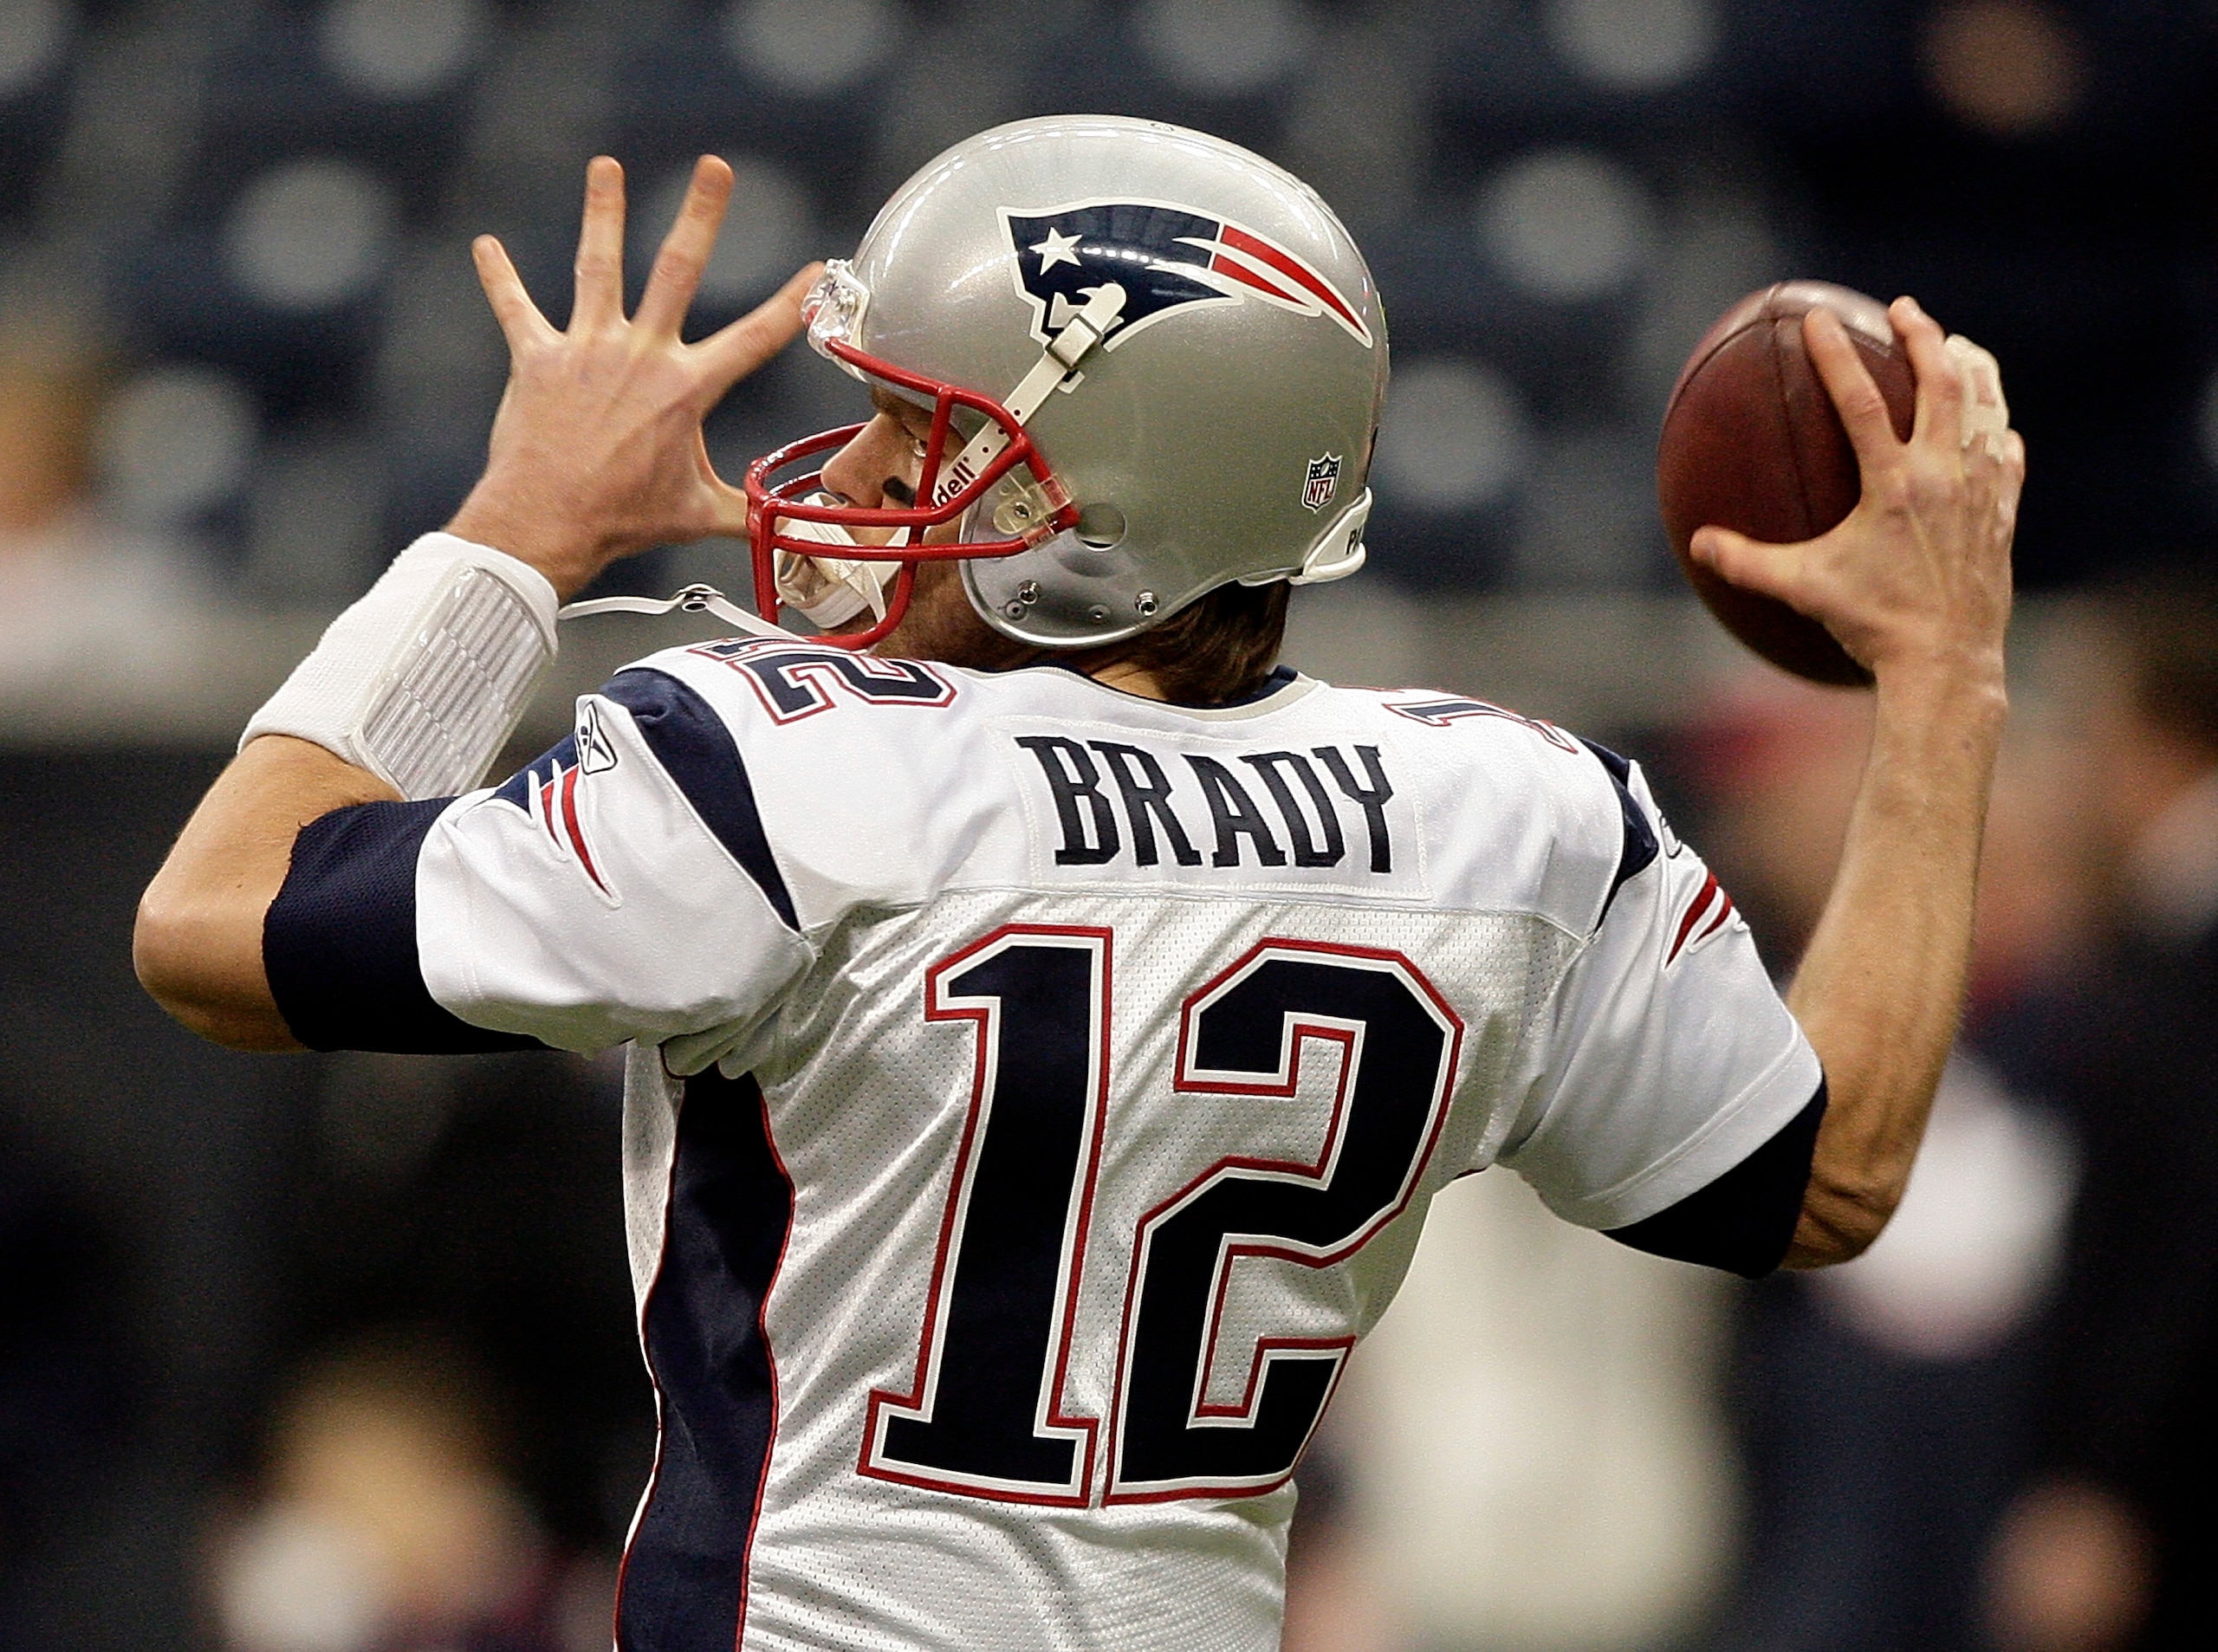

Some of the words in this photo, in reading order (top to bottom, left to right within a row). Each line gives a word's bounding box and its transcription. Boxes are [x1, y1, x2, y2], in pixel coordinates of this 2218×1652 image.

[1307, 478, 1333, 503] NFL
[1014, 735, 1394, 873] BRADY
[856, 923, 1465, 1509] 12
